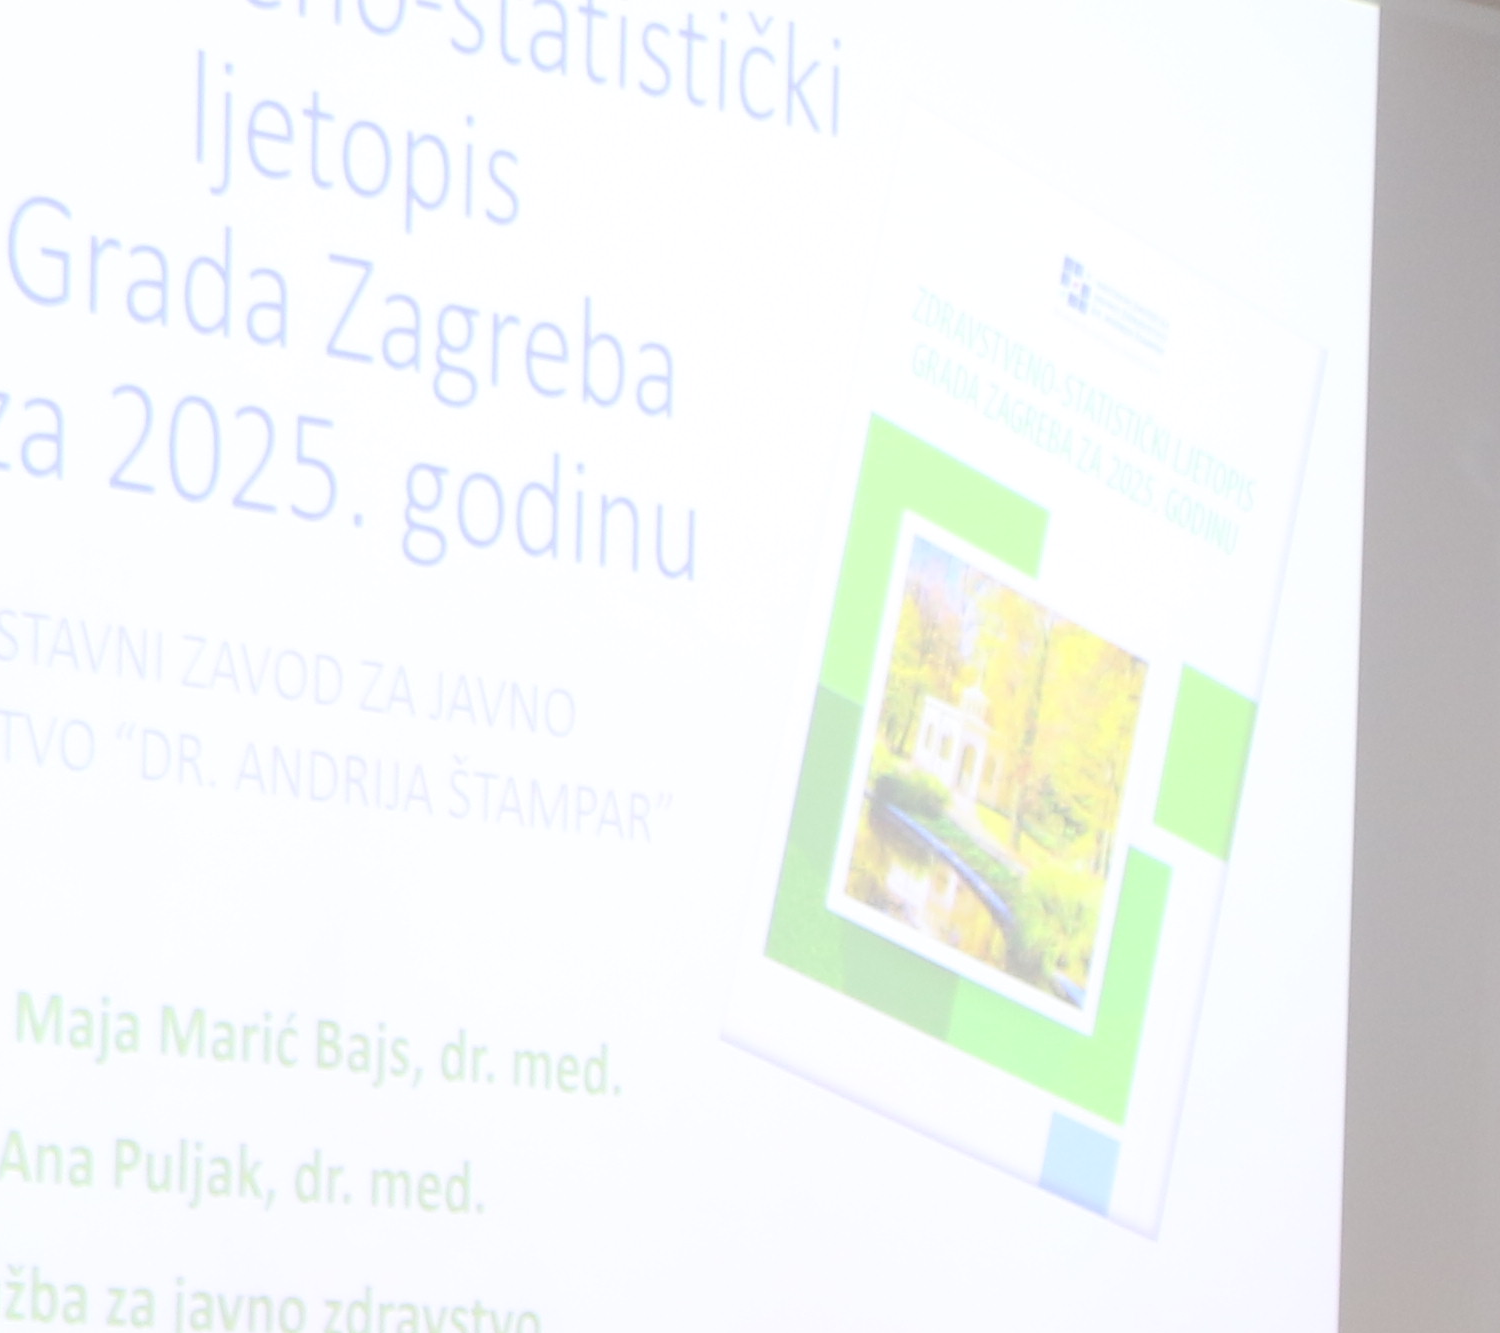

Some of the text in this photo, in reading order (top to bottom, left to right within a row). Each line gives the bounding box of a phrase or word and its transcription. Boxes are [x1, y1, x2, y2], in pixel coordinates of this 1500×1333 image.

[244, 0, 844, 137] -statistički
[195, 48, 522, 233] ljetopis
[5, 195, 676, 420] Grada Zagreba
[109, 383, 365, 529] 2025.
[400, 451, 698, 582] godinu
[180, 634, 345, 707] ZAVOD
[359, 659, 417, 719] ZA
[428, 672, 578, 738] JAVNO
[234, 742, 434, 816] ANDRIJA
[13, 989, 141, 1064] Maja
[159, 1005, 299, 1068] Marić
[315, 1019, 424, 1089] Bajs,
[440, 1029, 496, 1085] dr.
[512, 1043, 624, 1097] med.
[113, 1137, 278, 1212] Puljak,
[294, 1149, 352, 1206] dr.
[370, 1160, 486, 1214] med.
[105, 1281, 155, 1329] za
